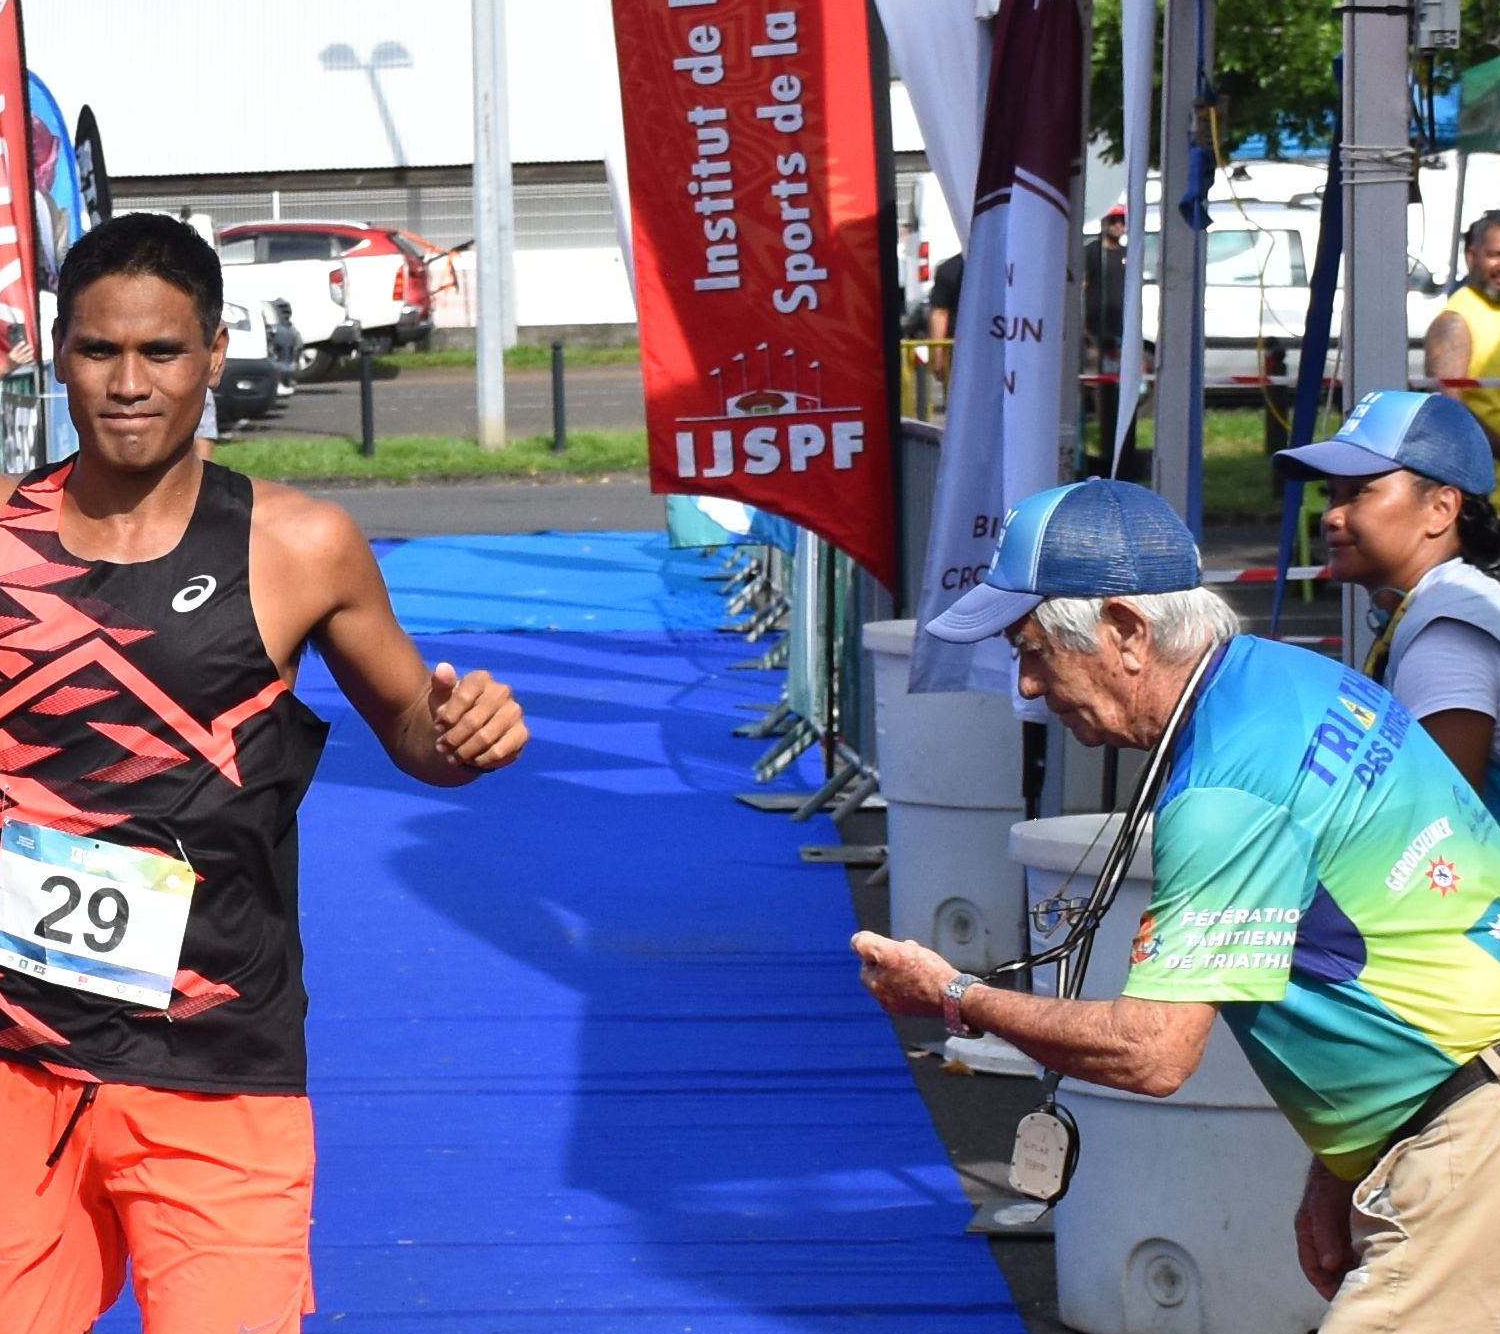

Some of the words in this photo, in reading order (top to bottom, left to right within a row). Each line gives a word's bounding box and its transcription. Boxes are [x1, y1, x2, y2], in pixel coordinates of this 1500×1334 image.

[673, 26, 725, 85] de
[751, 10, 798, 58] la
[757, 74, 803, 133] de
[689, 104, 741, 291] Institut
[773, 152, 828, 315] Sports
[675, 421, 865, 478] IJSPF
[1354, 740, 1394, 792] DES
[34, 875, 130, 953] 29
[1181, 906, 1301, 928] FÉDÉRATIO
[1185, 930, 1297, 948] TAHITIENN
[1165, 954, 1193, 970] DE
[1203, 953, 1291, 970] TRIATHL
